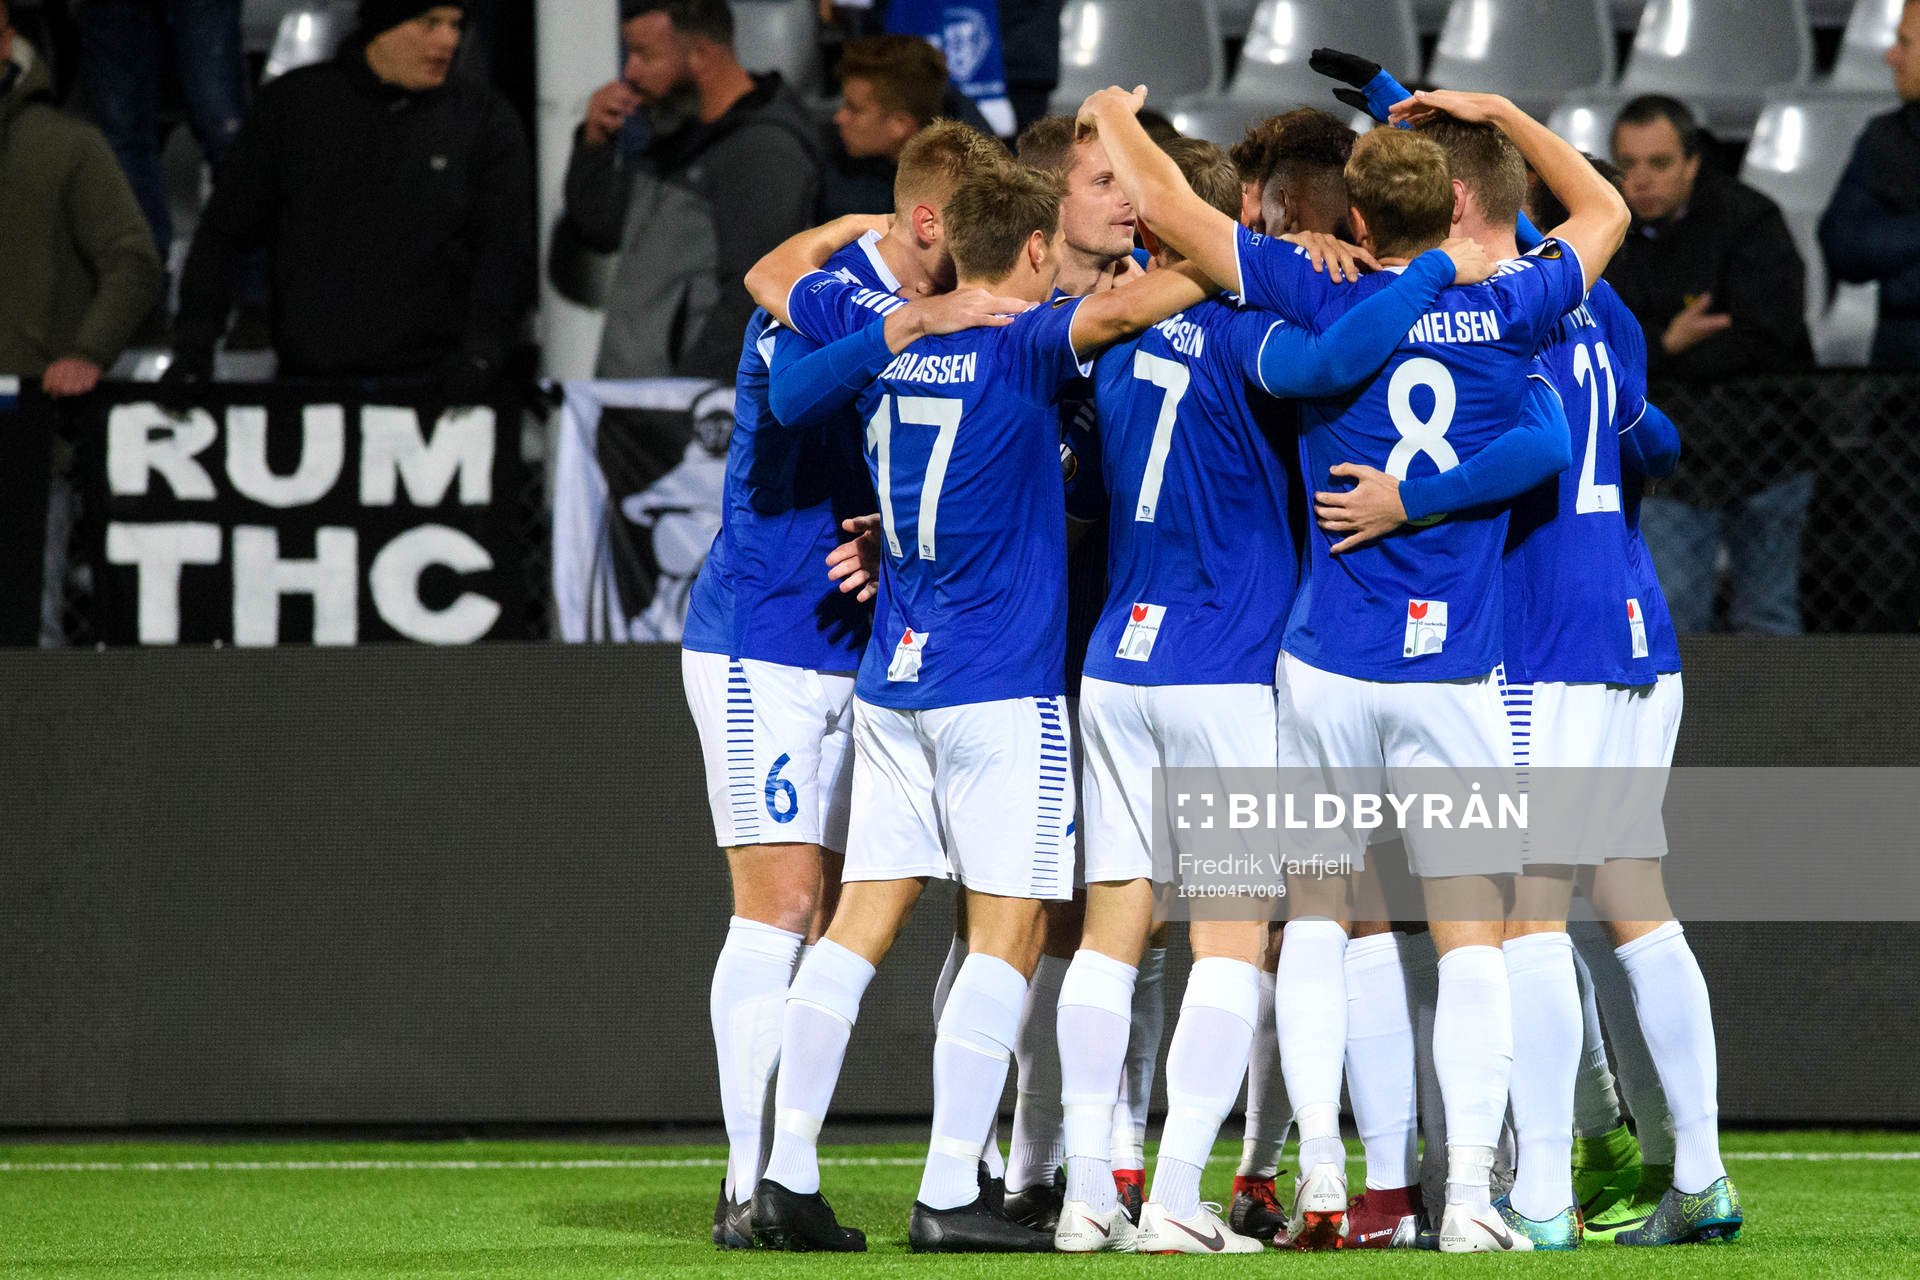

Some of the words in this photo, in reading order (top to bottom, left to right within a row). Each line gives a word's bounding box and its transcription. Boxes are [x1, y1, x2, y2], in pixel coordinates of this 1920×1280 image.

[1408, 309, 1500, 344] NIELSEN
[107, 402, 496, 508] RUM
[867, 394, 963, 561] 17
[1133, 349, 1190, 522] 7
[1385, 357, 1461, 526] 8
[106, 520, 501, 648] THC
[764, 752, 799, 825] 6
